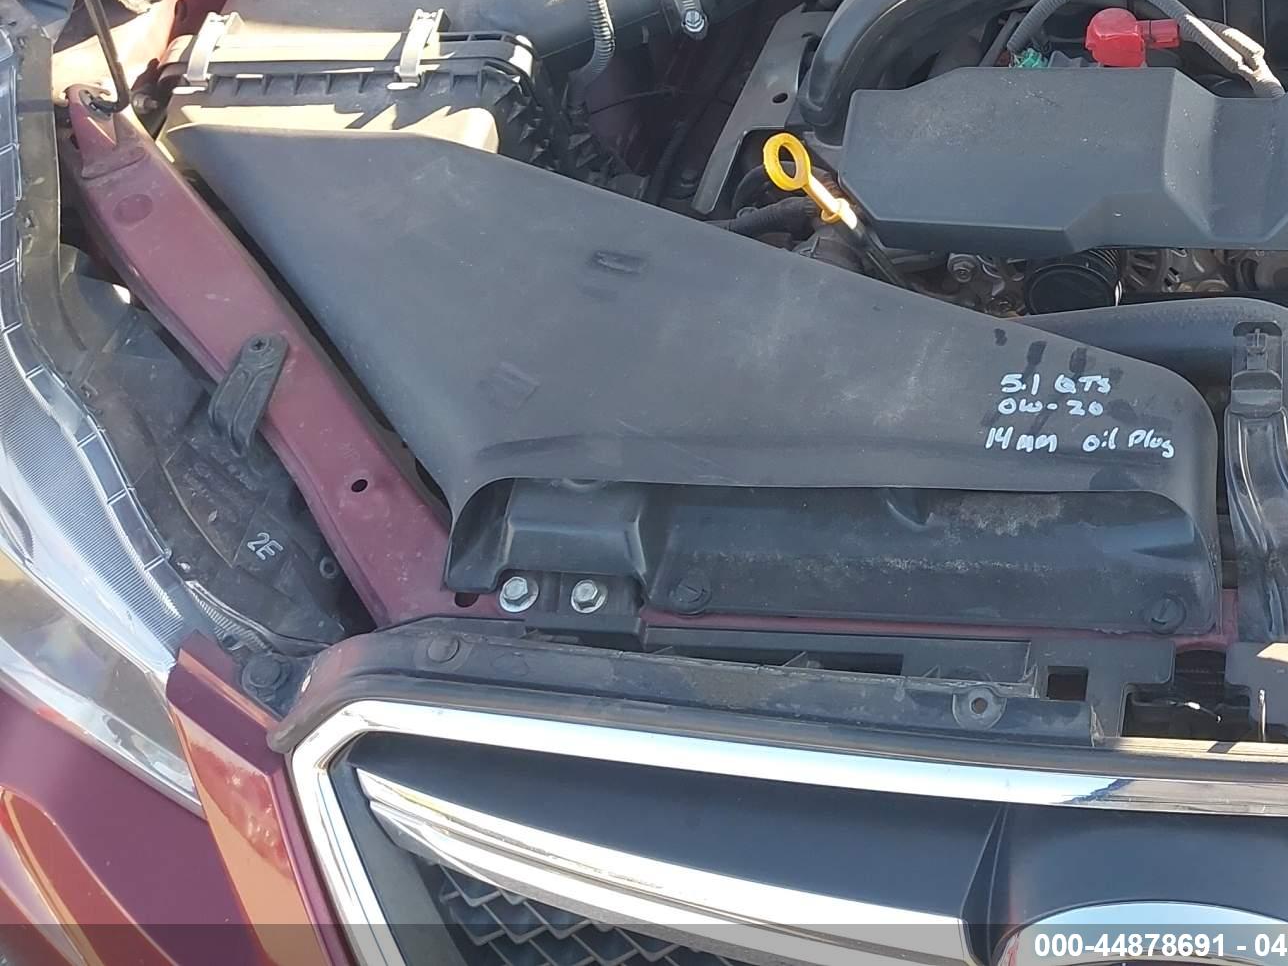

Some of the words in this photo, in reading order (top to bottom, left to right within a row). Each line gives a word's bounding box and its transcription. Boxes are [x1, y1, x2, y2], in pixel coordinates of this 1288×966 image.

[1000, 373, 1041, 396] 5.1
[1127, 428, 1175, 458] Plug
[247, 532, 284, 560] 2E
